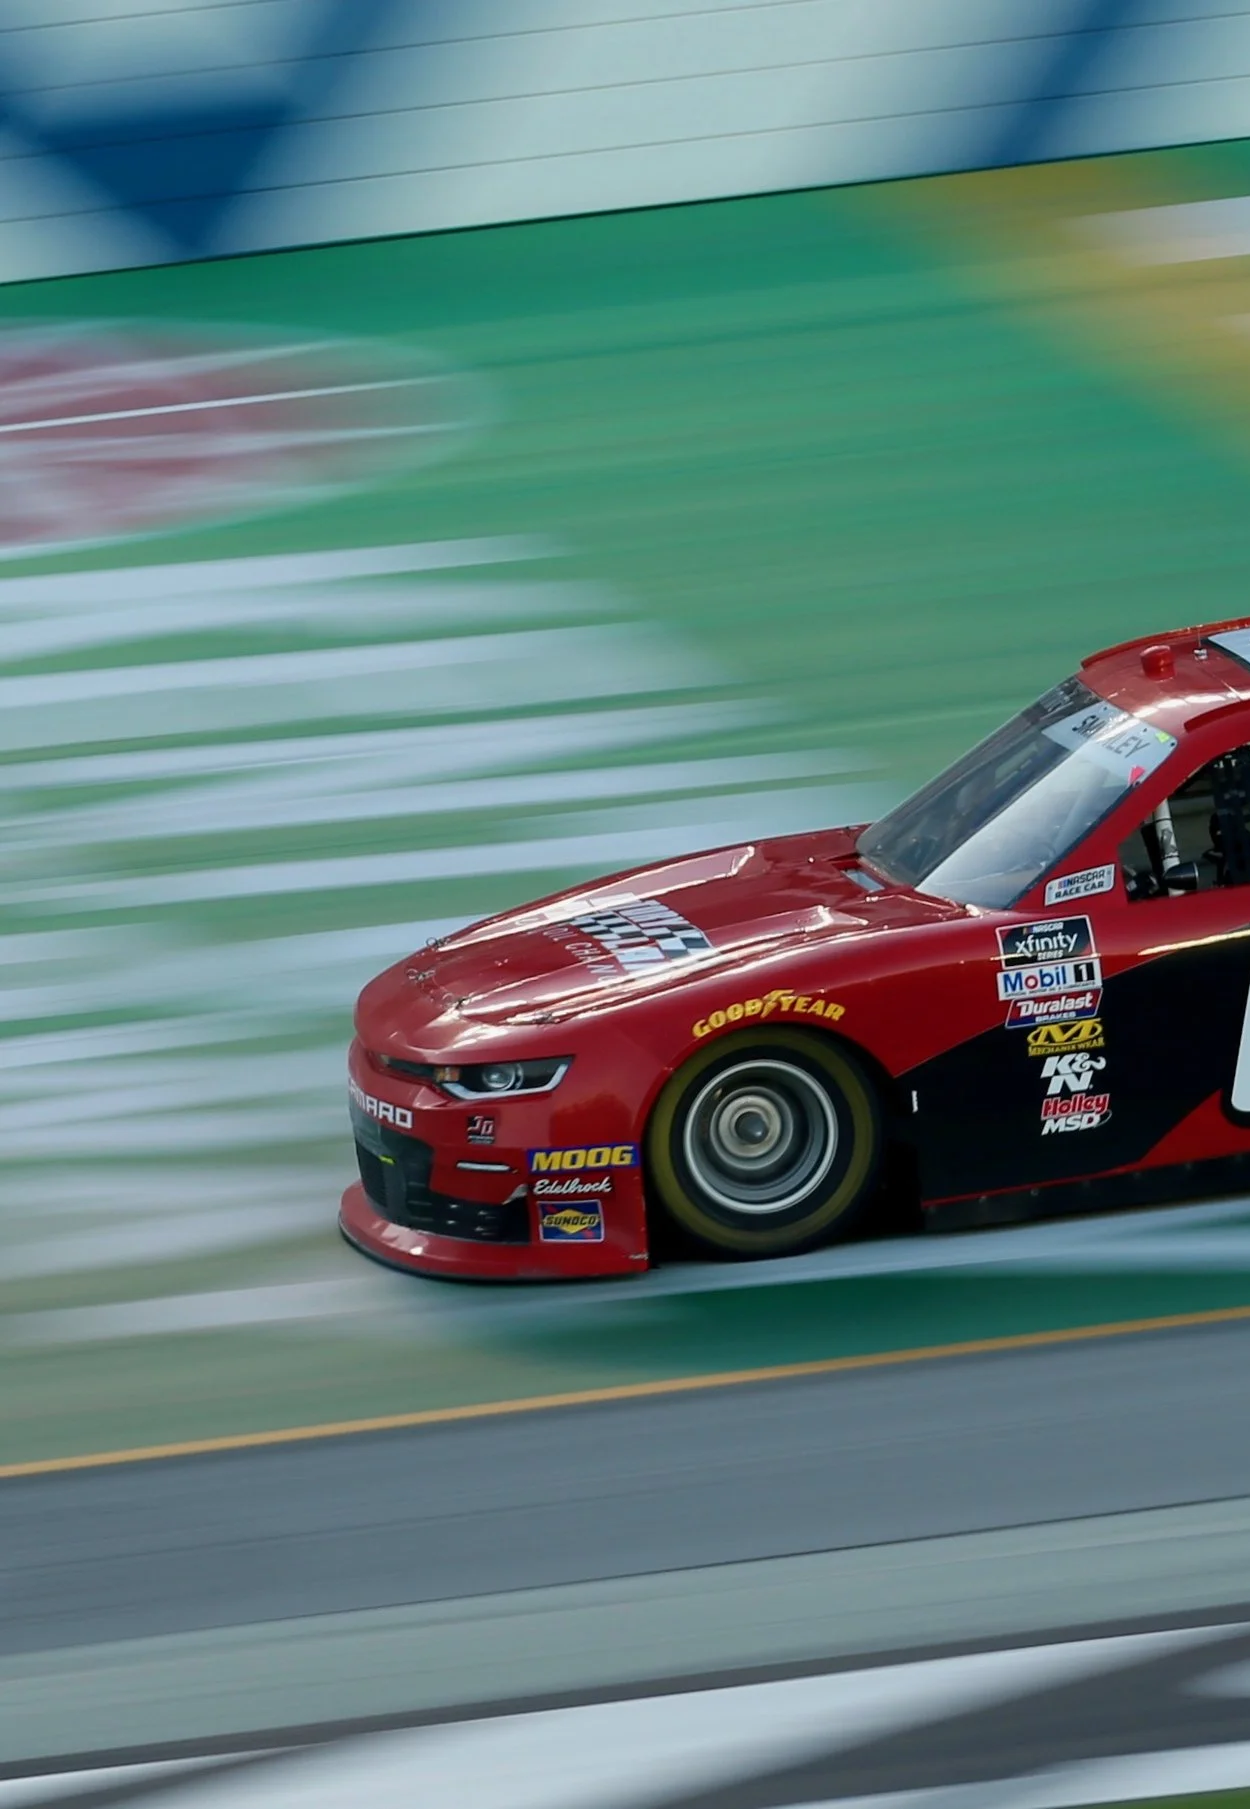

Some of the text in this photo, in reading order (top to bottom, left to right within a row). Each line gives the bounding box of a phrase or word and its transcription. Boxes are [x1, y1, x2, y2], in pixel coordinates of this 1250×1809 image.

[1055, 881, 1105, 899] RACE CAR
[1066, 869, 1105, 887] NASCAR
[1032, 922, 1064, 933] NASCAR
[1015, 932, 1078, 958] xfinity
[1003, 965, 1067, 993] Mobil
[692, 989, 846, 1038] GOODYEAR
[1017, 992, 1094, 1017] Duralast
[1035, 1012, 1076, 1023] BRAKES
[349, 1078, 412, 1129] AMARO
[1041, 1093, 1110, 1121] Holley
[1041, 1113, 1101, 1136] MSD
[532, 1146, 634, 1172] MOOG
[533, 1176, 612, 1195] Edelbrock
[545, 1214, 598, 1226] SUNOCO
